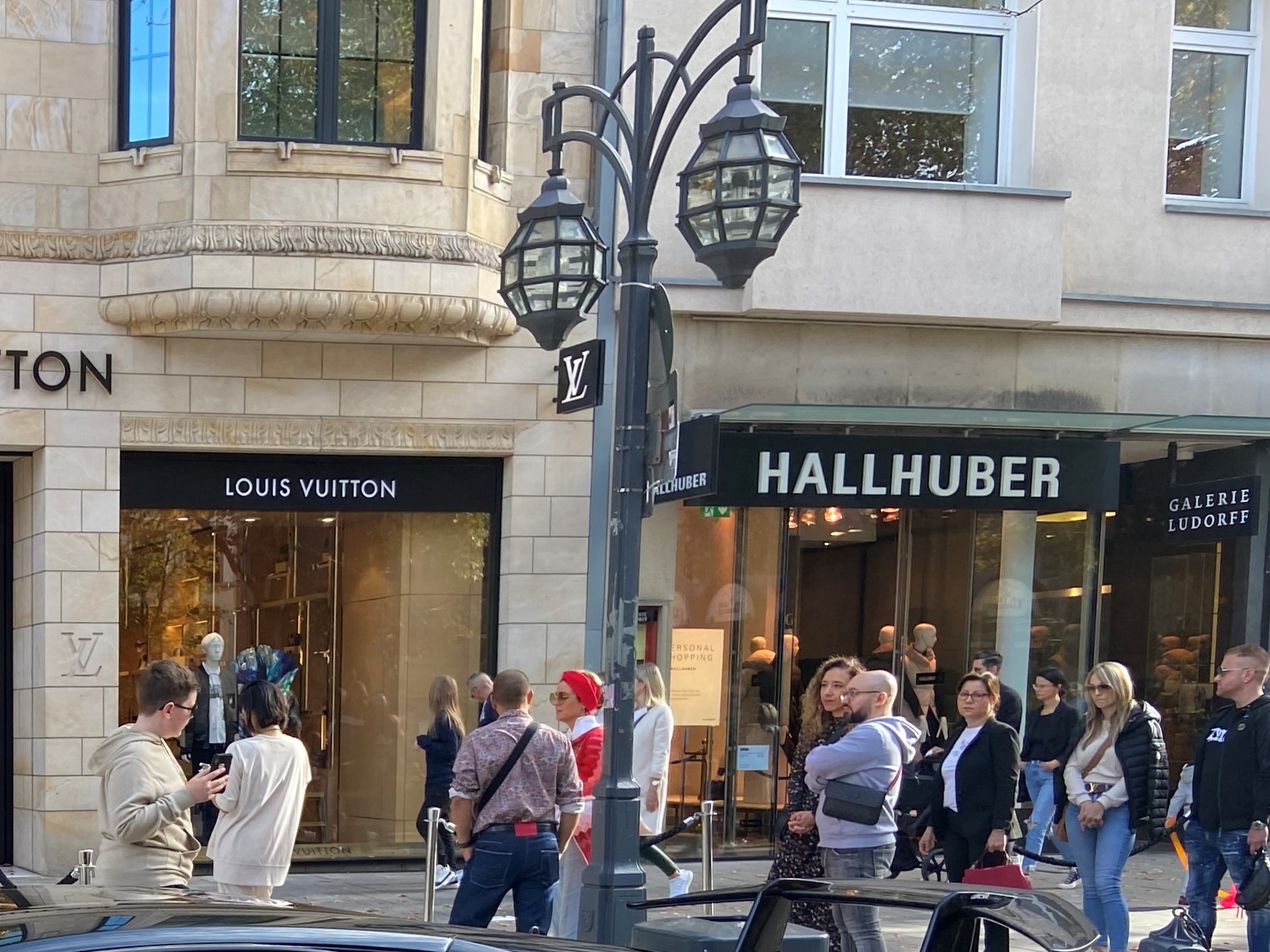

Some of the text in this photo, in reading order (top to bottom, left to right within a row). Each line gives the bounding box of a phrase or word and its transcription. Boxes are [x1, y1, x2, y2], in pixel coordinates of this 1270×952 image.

[757, 451, 1060, 498] HALLHUBER
[225, 477, 396, 499] LOUIS VUITTON
[1169, 488, 1250, 512] GALERIE
[1168, 509, 1250, 532] LUDORFF
[671, 644, 715, 652] ERSONAL
[671, 653, 714, 662] HOPPING
